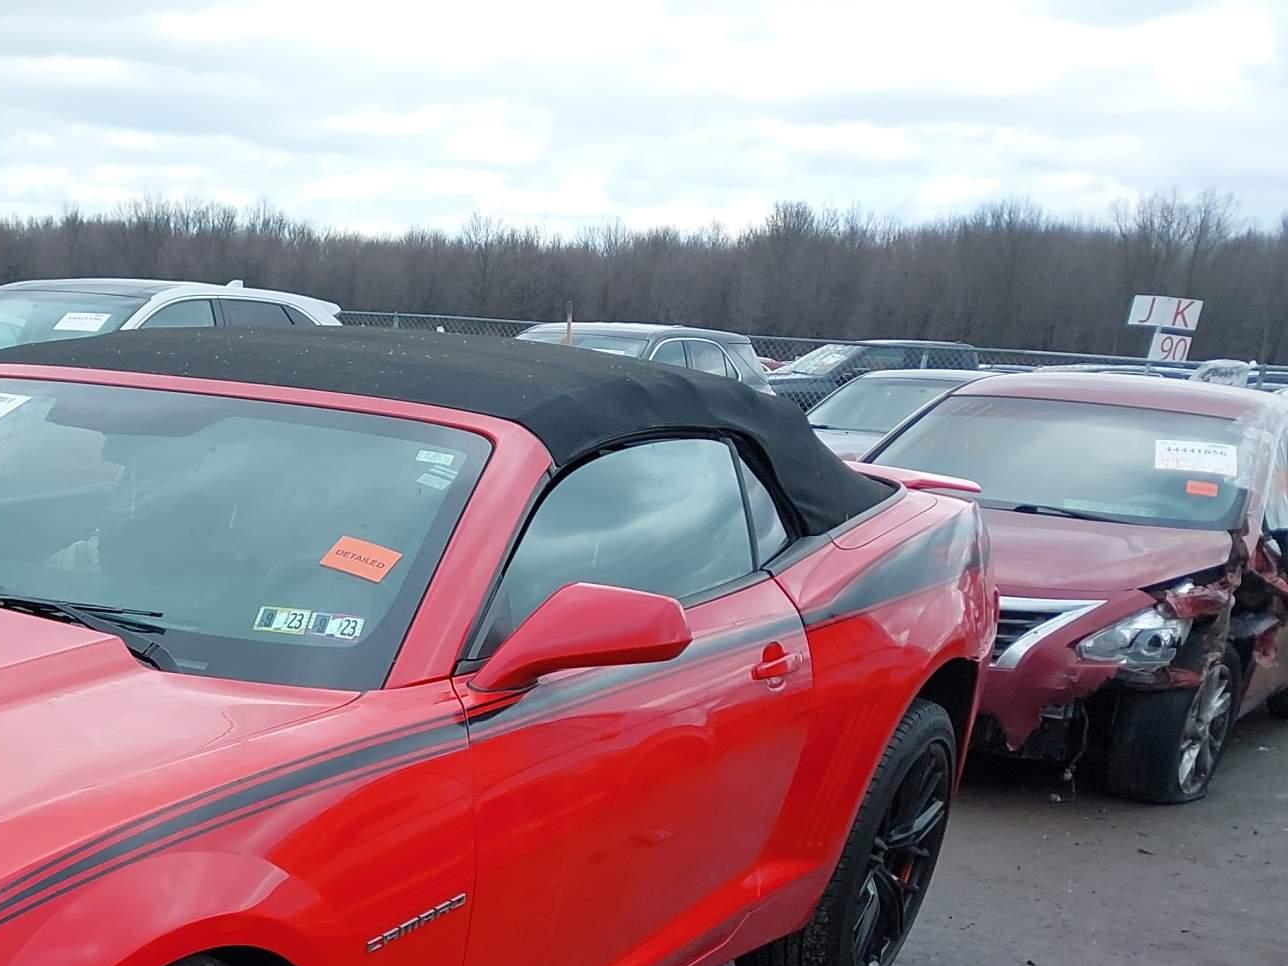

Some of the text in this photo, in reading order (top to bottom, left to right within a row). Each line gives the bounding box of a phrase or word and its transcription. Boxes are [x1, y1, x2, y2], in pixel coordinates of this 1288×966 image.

[1137, 297, 1195, 328] J K
[1160, 336, 1188, 361] 90
[335, 548, 386, 570] DETAILED
[287, 612, 305, 630] 23
[341, 619, 358, 636] 23
[367, 892, 466, 953] CAMARO
